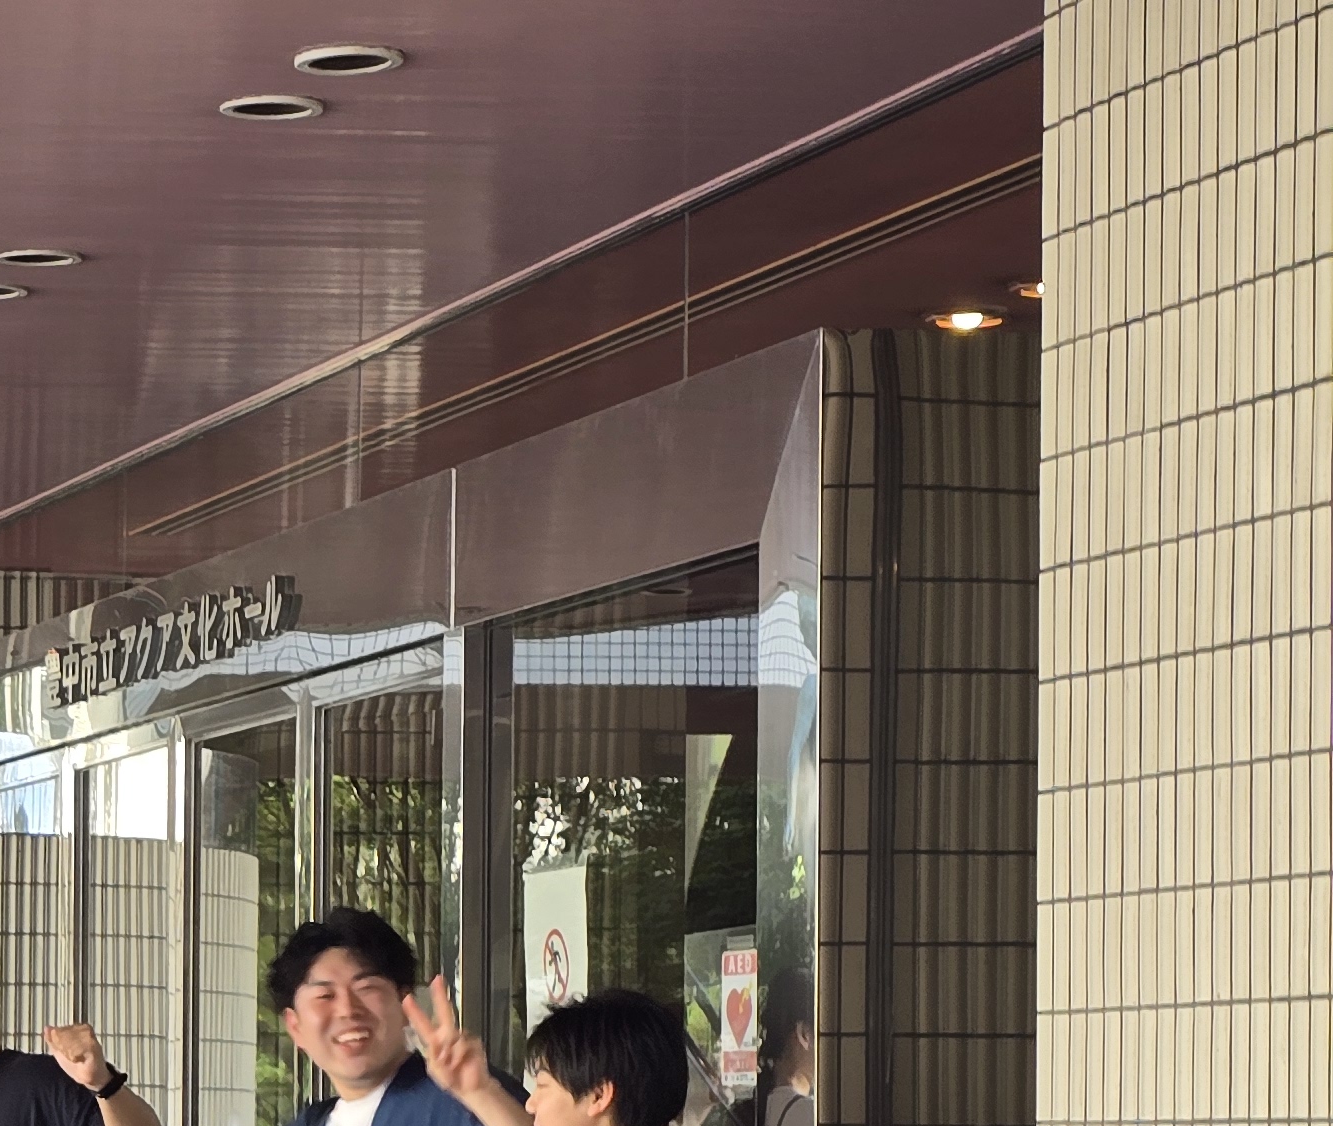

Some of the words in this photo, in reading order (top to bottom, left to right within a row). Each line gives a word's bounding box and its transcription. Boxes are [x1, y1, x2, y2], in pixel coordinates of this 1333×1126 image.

[44, 574, 283, 708] 豊中市立アクア文化ホール
[728, 954, 752, 974] AED
